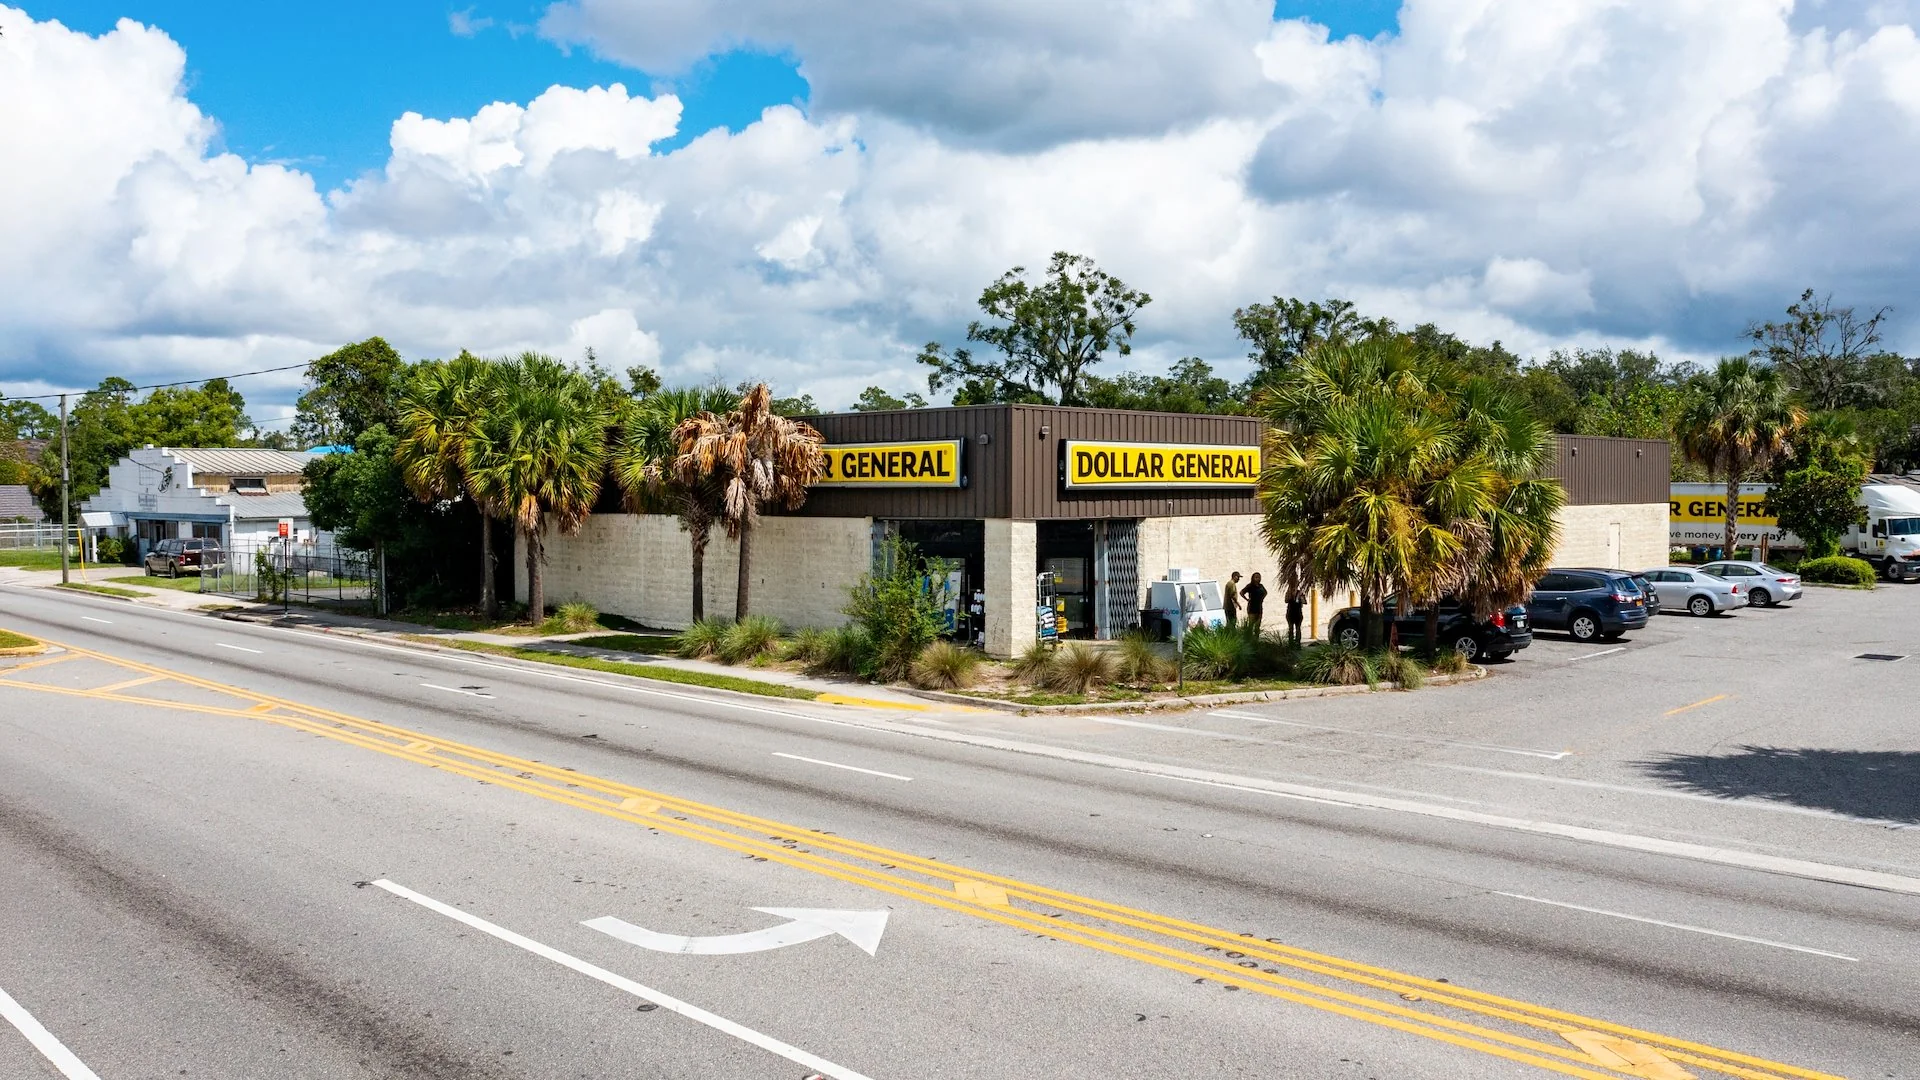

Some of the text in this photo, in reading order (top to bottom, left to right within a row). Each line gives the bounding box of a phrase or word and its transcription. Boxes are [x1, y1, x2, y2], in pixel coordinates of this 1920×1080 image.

[841, 450, 950, 478] GENERAL
[1076, 451, 1258, 478] DOLLAR GENERAL
[1684, 531, 1723, 541] money.
[1736, 533, 1759, 541] very
